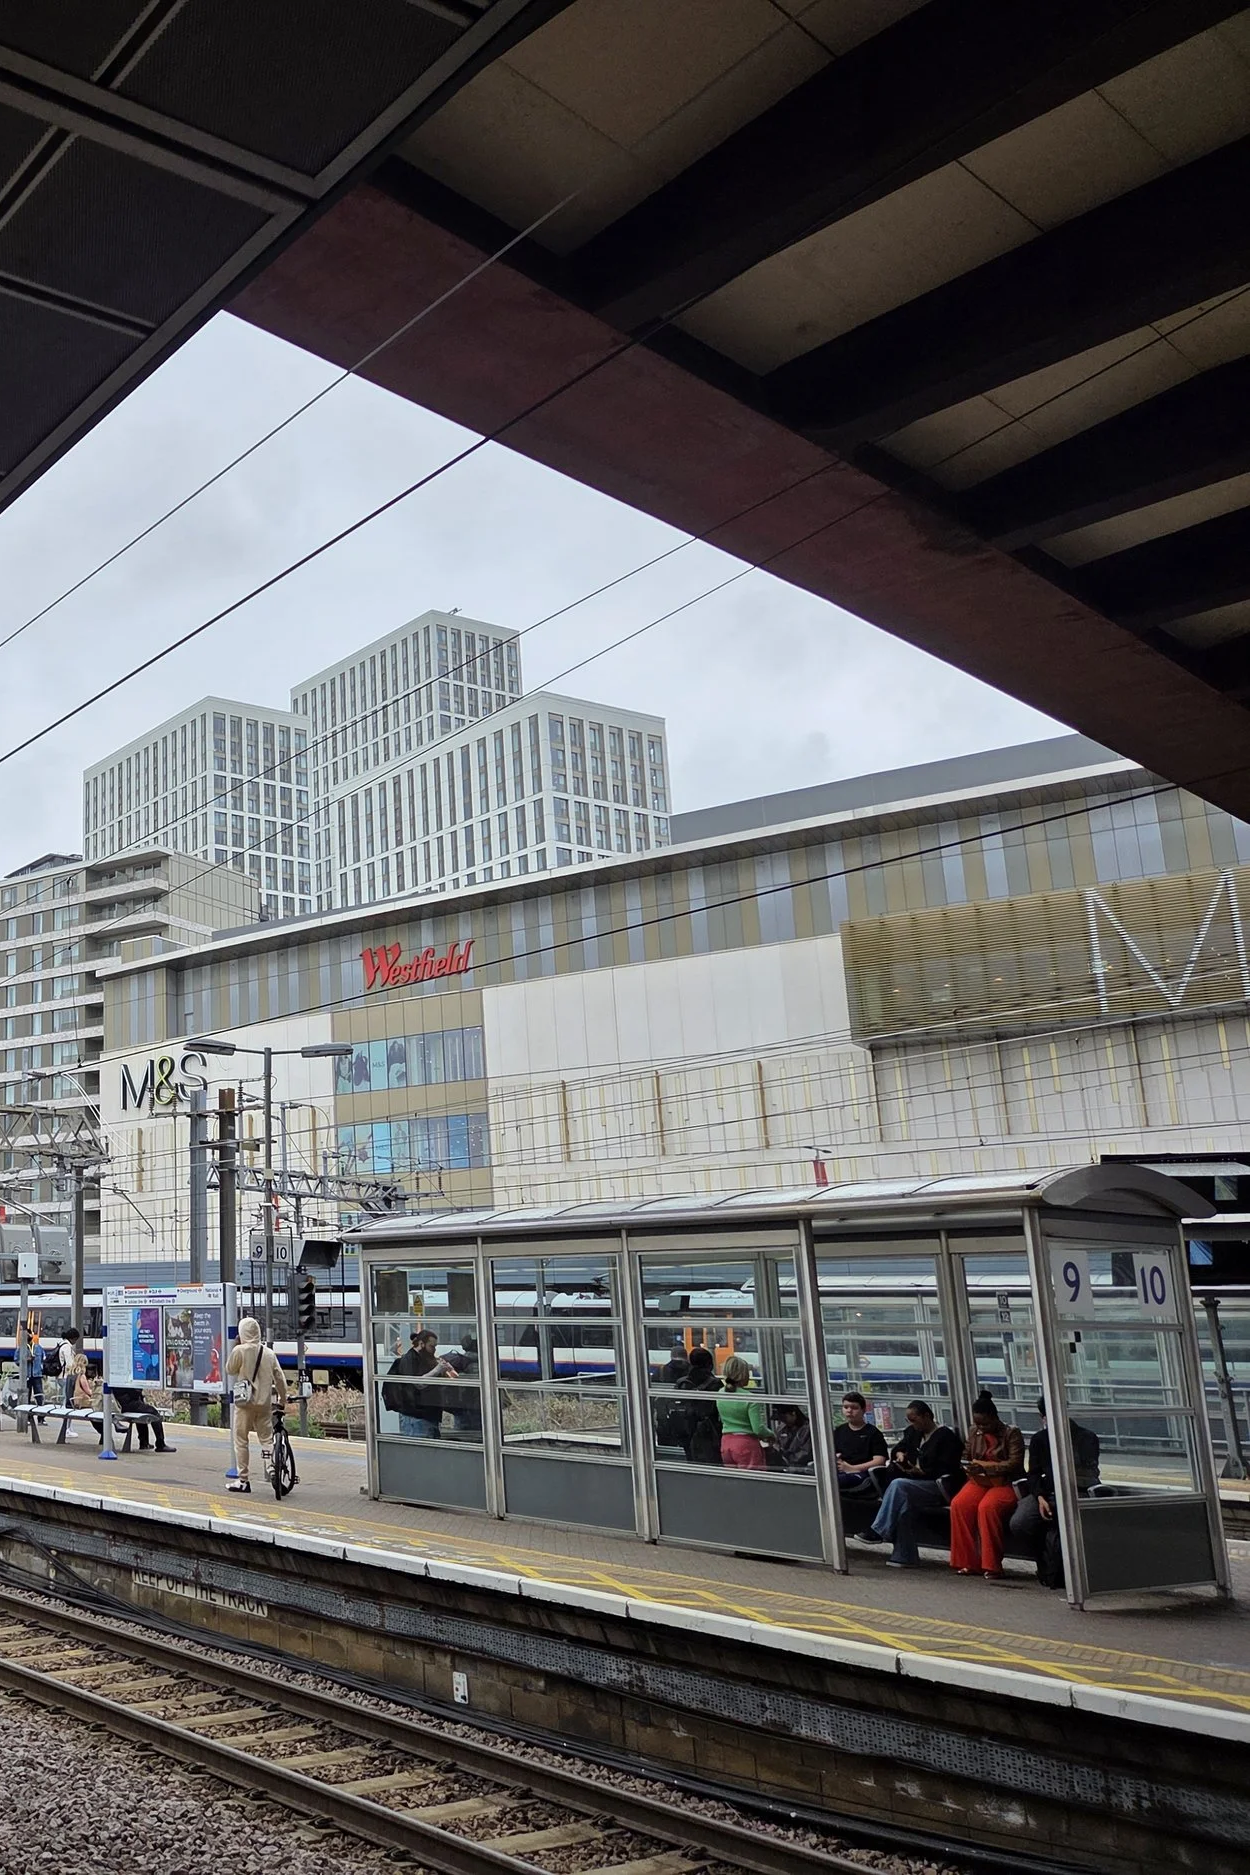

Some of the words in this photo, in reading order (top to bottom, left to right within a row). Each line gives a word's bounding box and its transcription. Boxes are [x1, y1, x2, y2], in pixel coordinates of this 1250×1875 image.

[359, 940, 475, 990] Westfield
[121, 1052, 208, 1111] M&S
[255, 1245, 263, 1259] 9
[276, 1246, 288, 1260] 10
[999, 1295, 1007, 1305] 10
[1063, 1261, 1081, 1303] 9
[1140, 1265, 1166, 1306] 10
[1001, 1312, 1010, 1322] 12
[134, 1569, 163, 1586] KEEP
[166, 1575, 189, 1594] OFF
[194, 1583, 217, 1602] THE
[221, 1591, 266, 1616] TRACK
